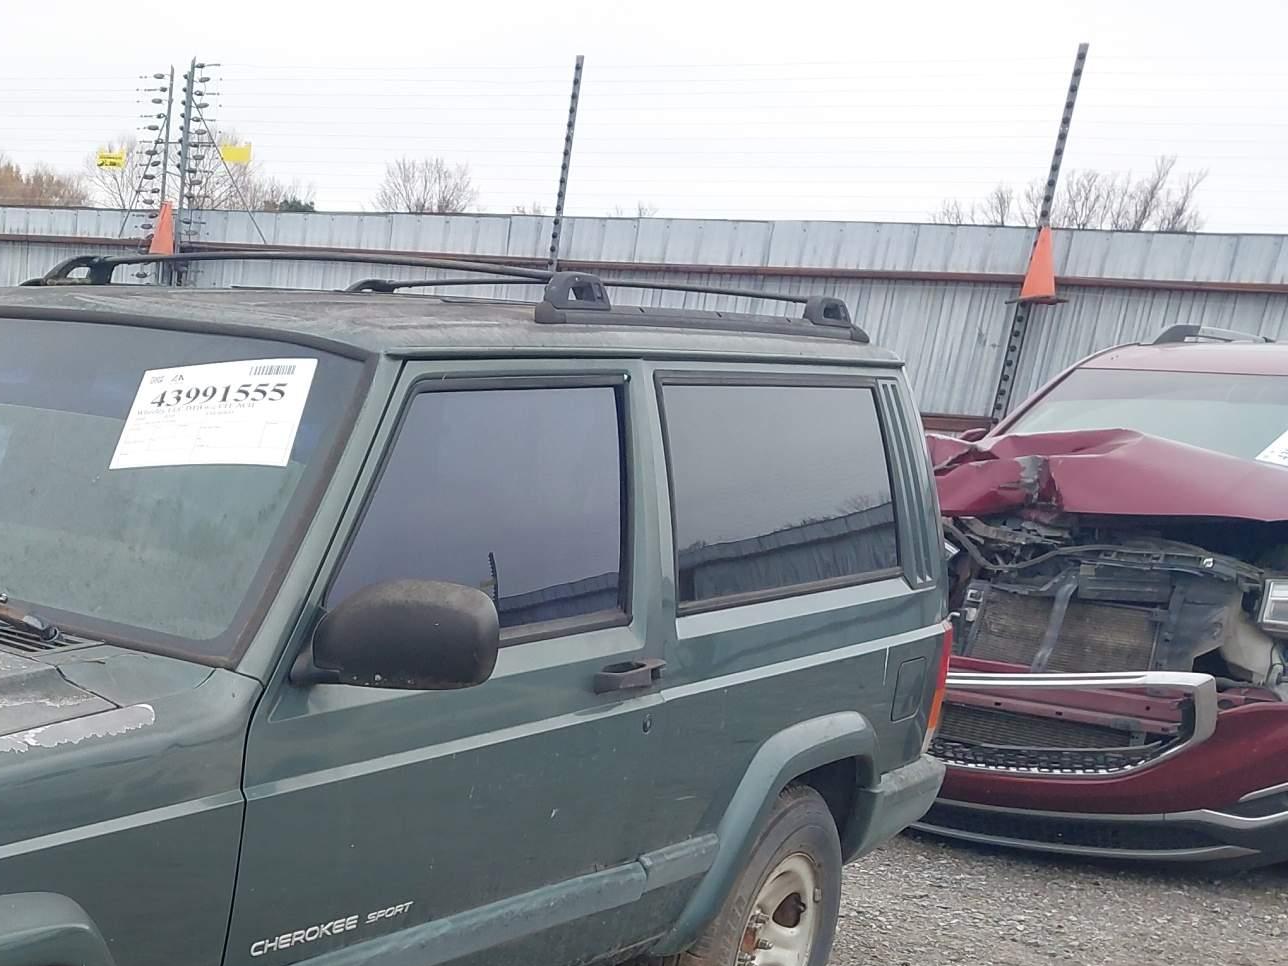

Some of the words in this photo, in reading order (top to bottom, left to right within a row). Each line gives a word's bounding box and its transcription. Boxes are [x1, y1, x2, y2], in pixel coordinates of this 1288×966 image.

[150, 382, 289, 408] 43991555
[249, 914, 359, 957] CHEROKEE
[365, 900, 414, 923] SPORT
